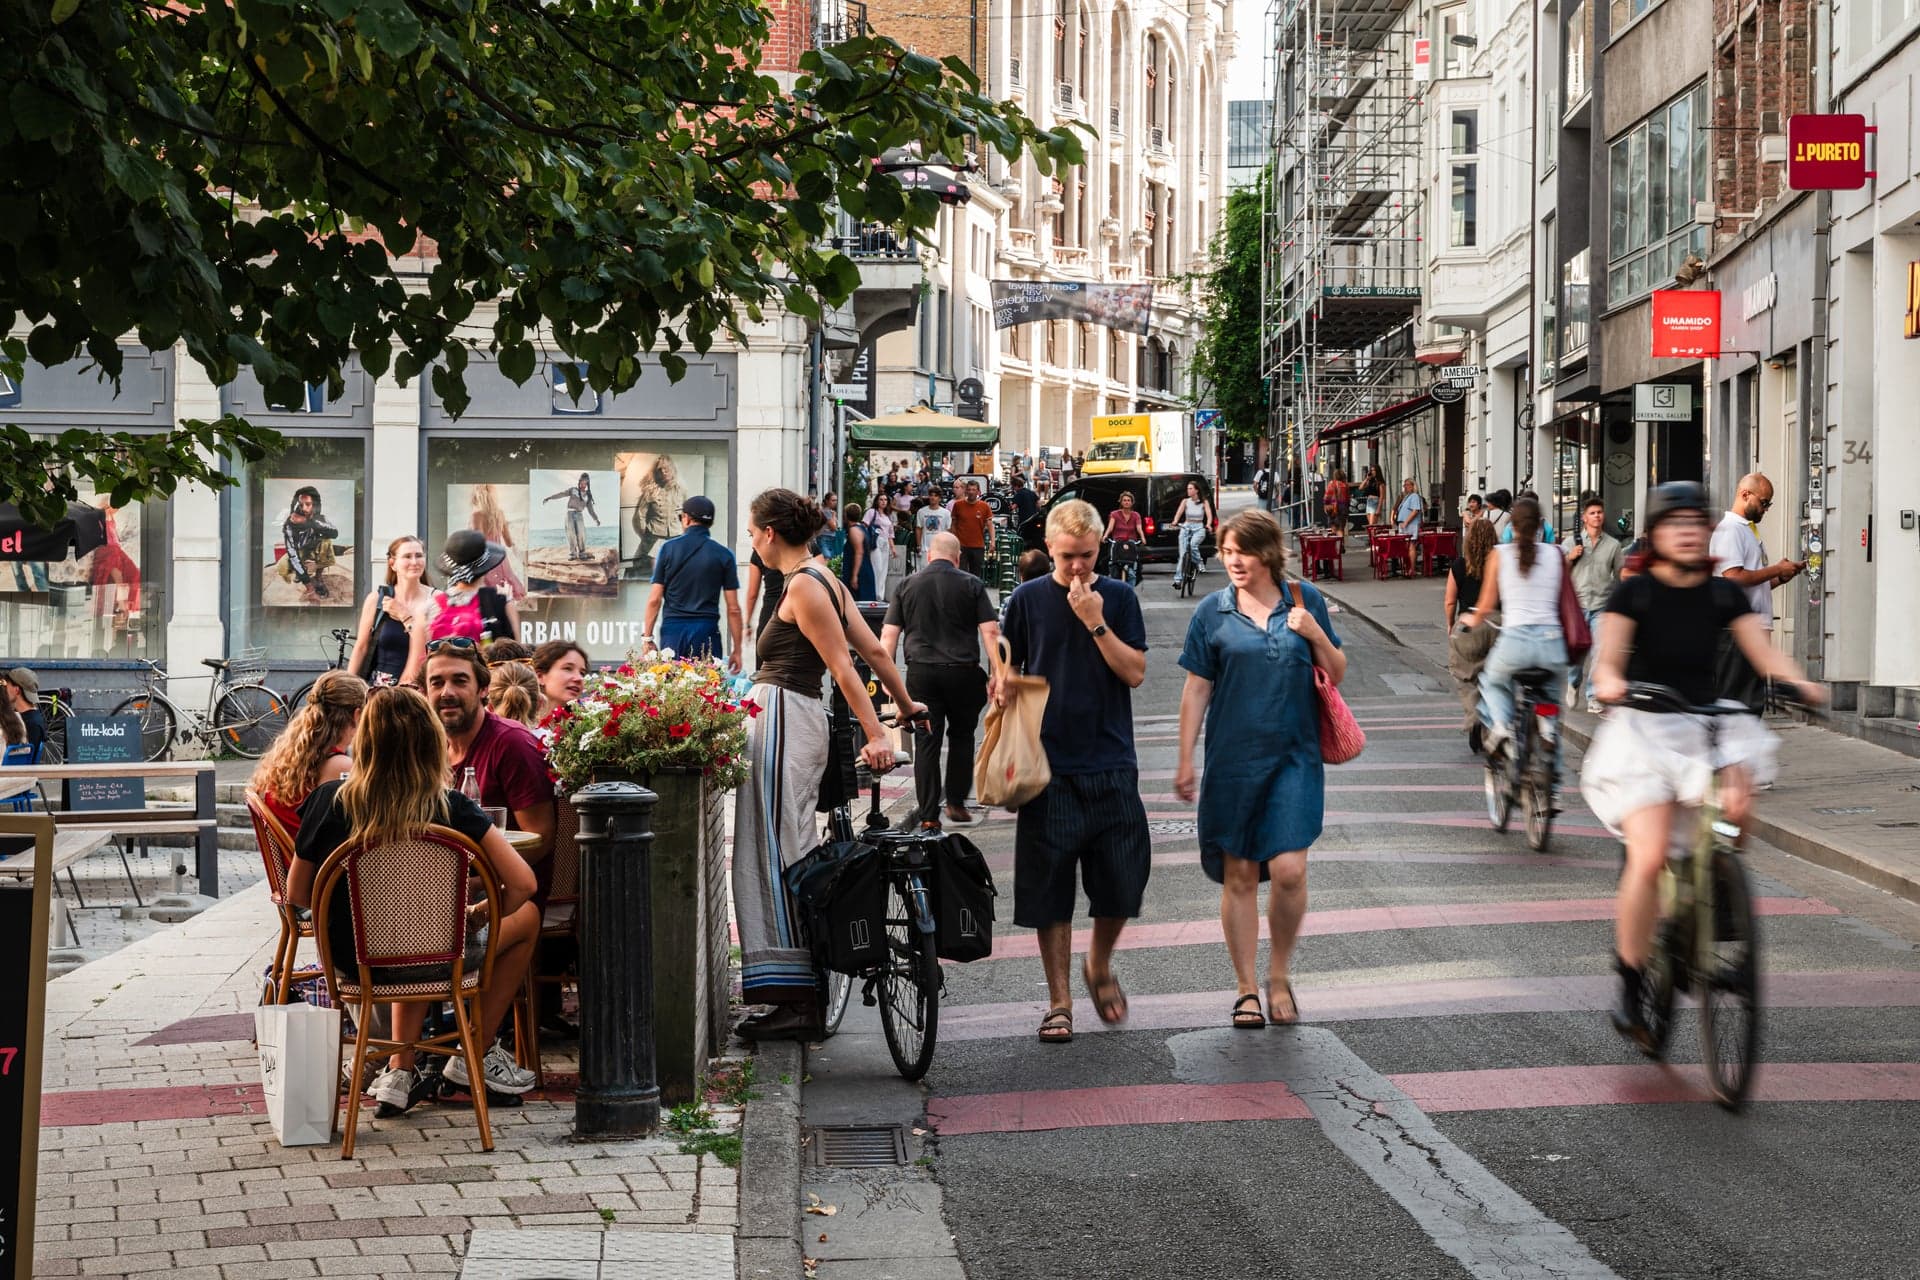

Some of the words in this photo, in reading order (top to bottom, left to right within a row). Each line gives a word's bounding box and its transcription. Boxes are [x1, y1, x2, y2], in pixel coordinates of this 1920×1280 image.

[1806, 142, 1860, 161] PURETO
[1663, 316, 1712, 326] UMAMIDO
[1443, 366, 1480, 378] AMERICA
[1450, 378, 1473, 389] TODAY
[1842, 440, 1873, 465] 34
[1, 529, 23, 554] el
[520, 620, 577, 645] RBAN
[80, 723, 125, 737] fritz-kola
[0, 1047, 18, 1076] 7
